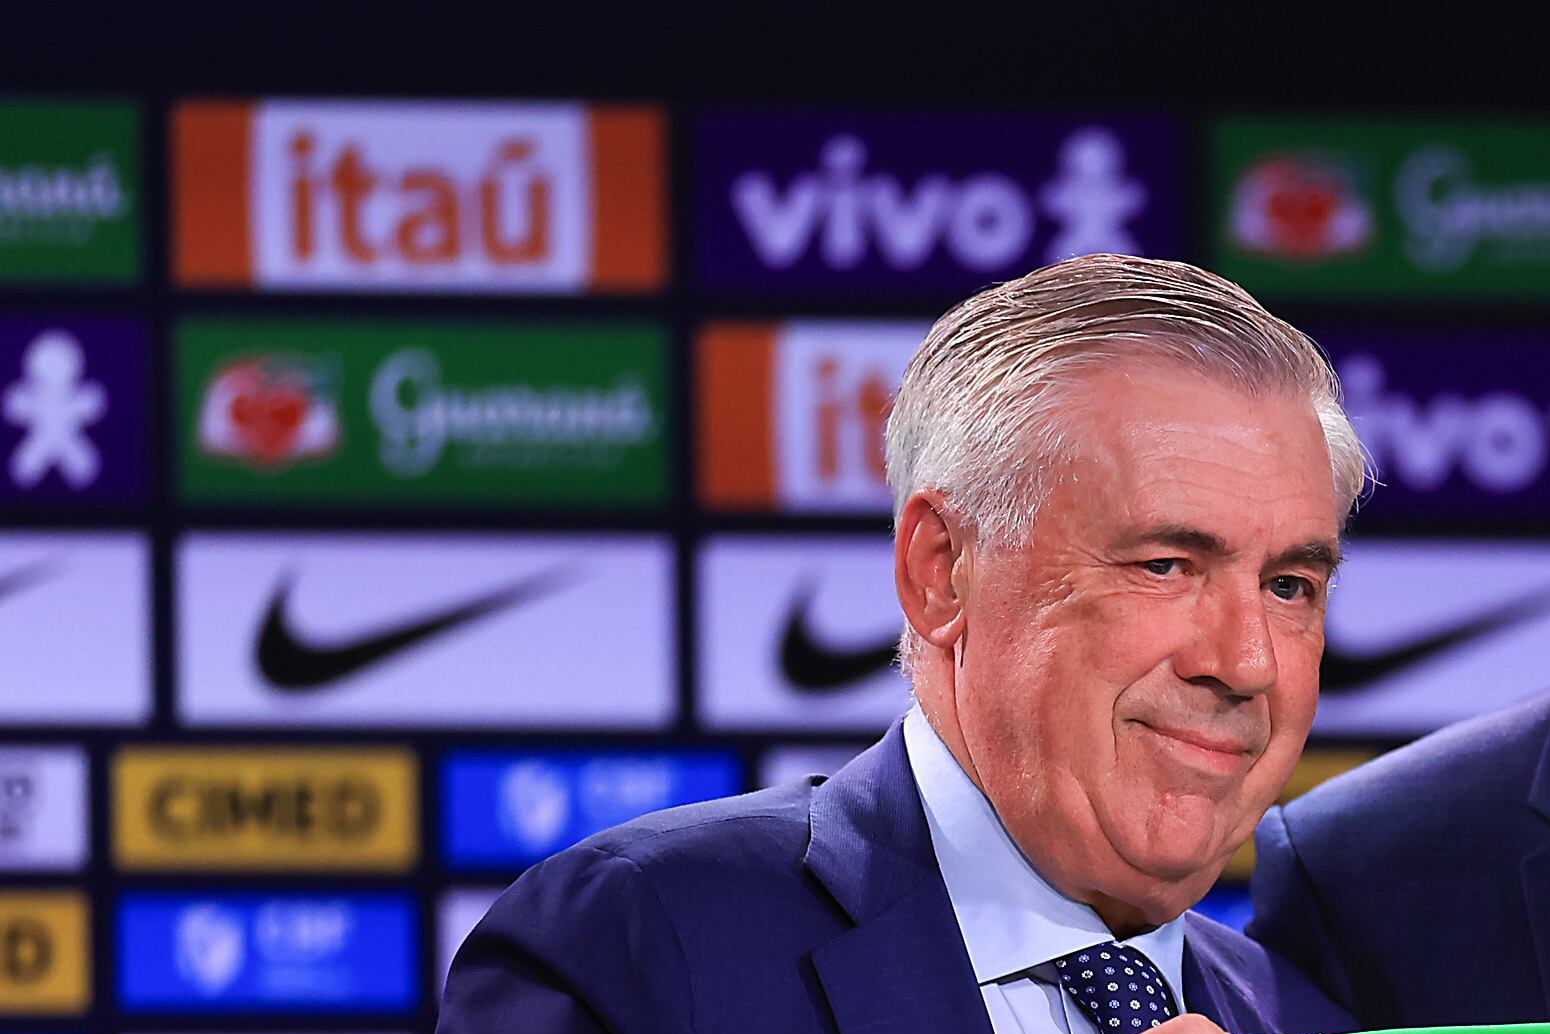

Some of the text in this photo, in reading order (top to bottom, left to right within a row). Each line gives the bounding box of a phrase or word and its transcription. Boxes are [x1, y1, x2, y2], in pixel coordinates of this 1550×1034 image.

[289, 132, 552, 265] itaú
[731, 133, 1034, 270] vivo
[146, 774, 383, 844] CIMED
